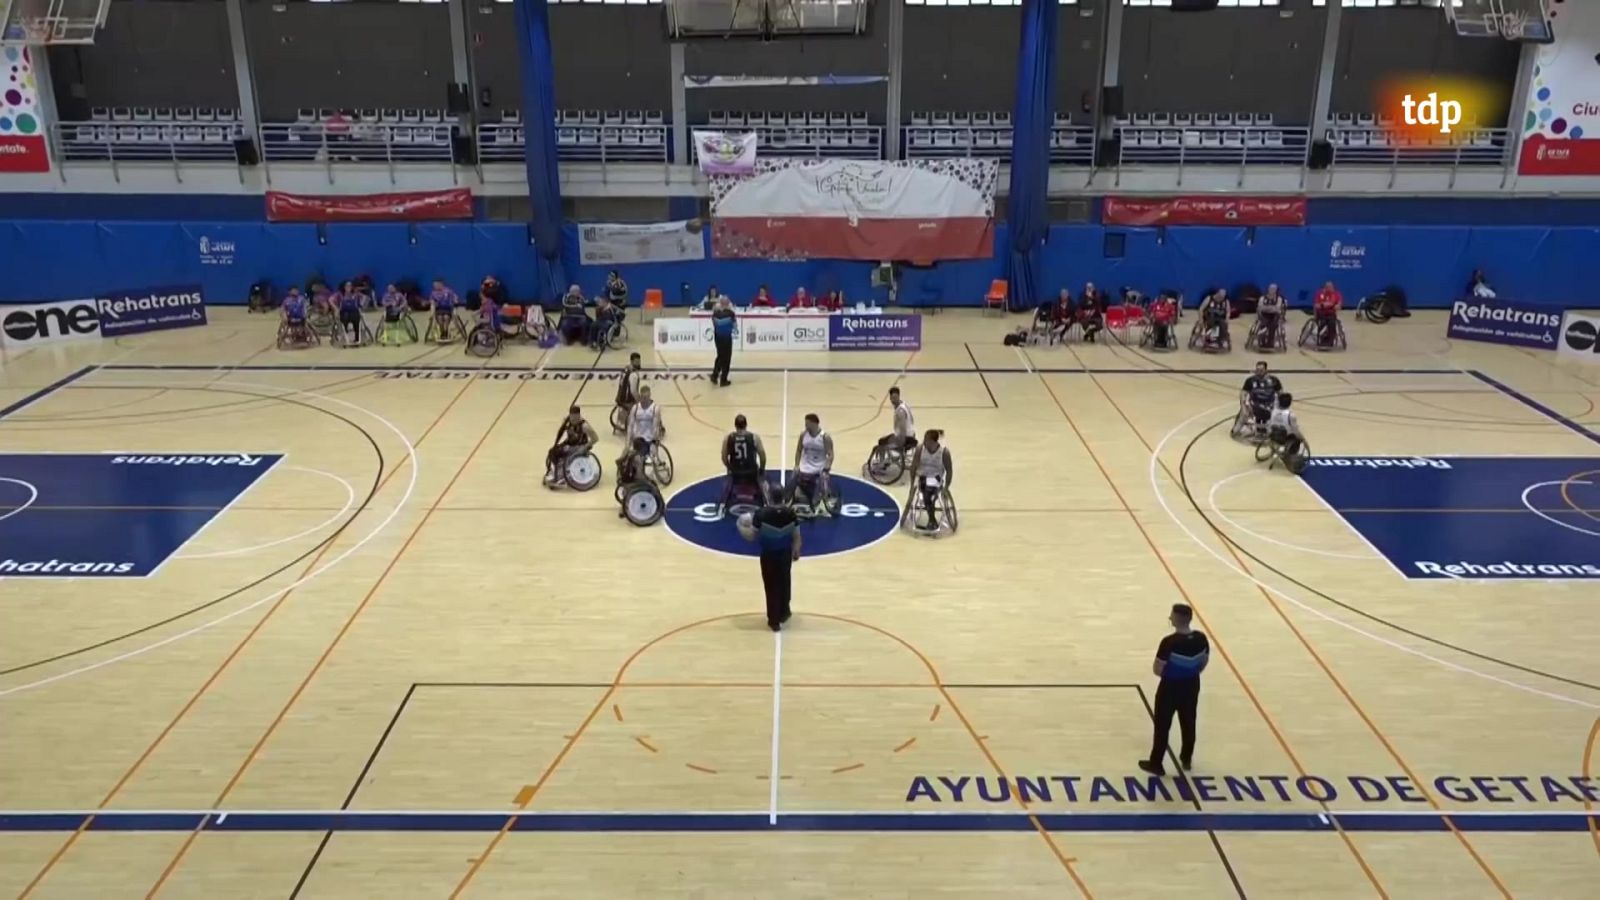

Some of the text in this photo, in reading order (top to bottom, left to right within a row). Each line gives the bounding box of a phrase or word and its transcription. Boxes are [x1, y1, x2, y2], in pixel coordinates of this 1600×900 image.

[100, 292, 201, 319] Rehatrans
[1453, 300, 1560, 327] Rehatrans
[842, 317, 908, 333] Rehatrans
[110, 454, 262, 467] Rehatrans
[734, 443, 748, 460] 51
[1309, 456, 1453, 470] Rehatran
[1415, 561, 1600, 580] Rehatrans
[906, 776, 1600, 802] AYUNTAMIENTO DE GETAF
